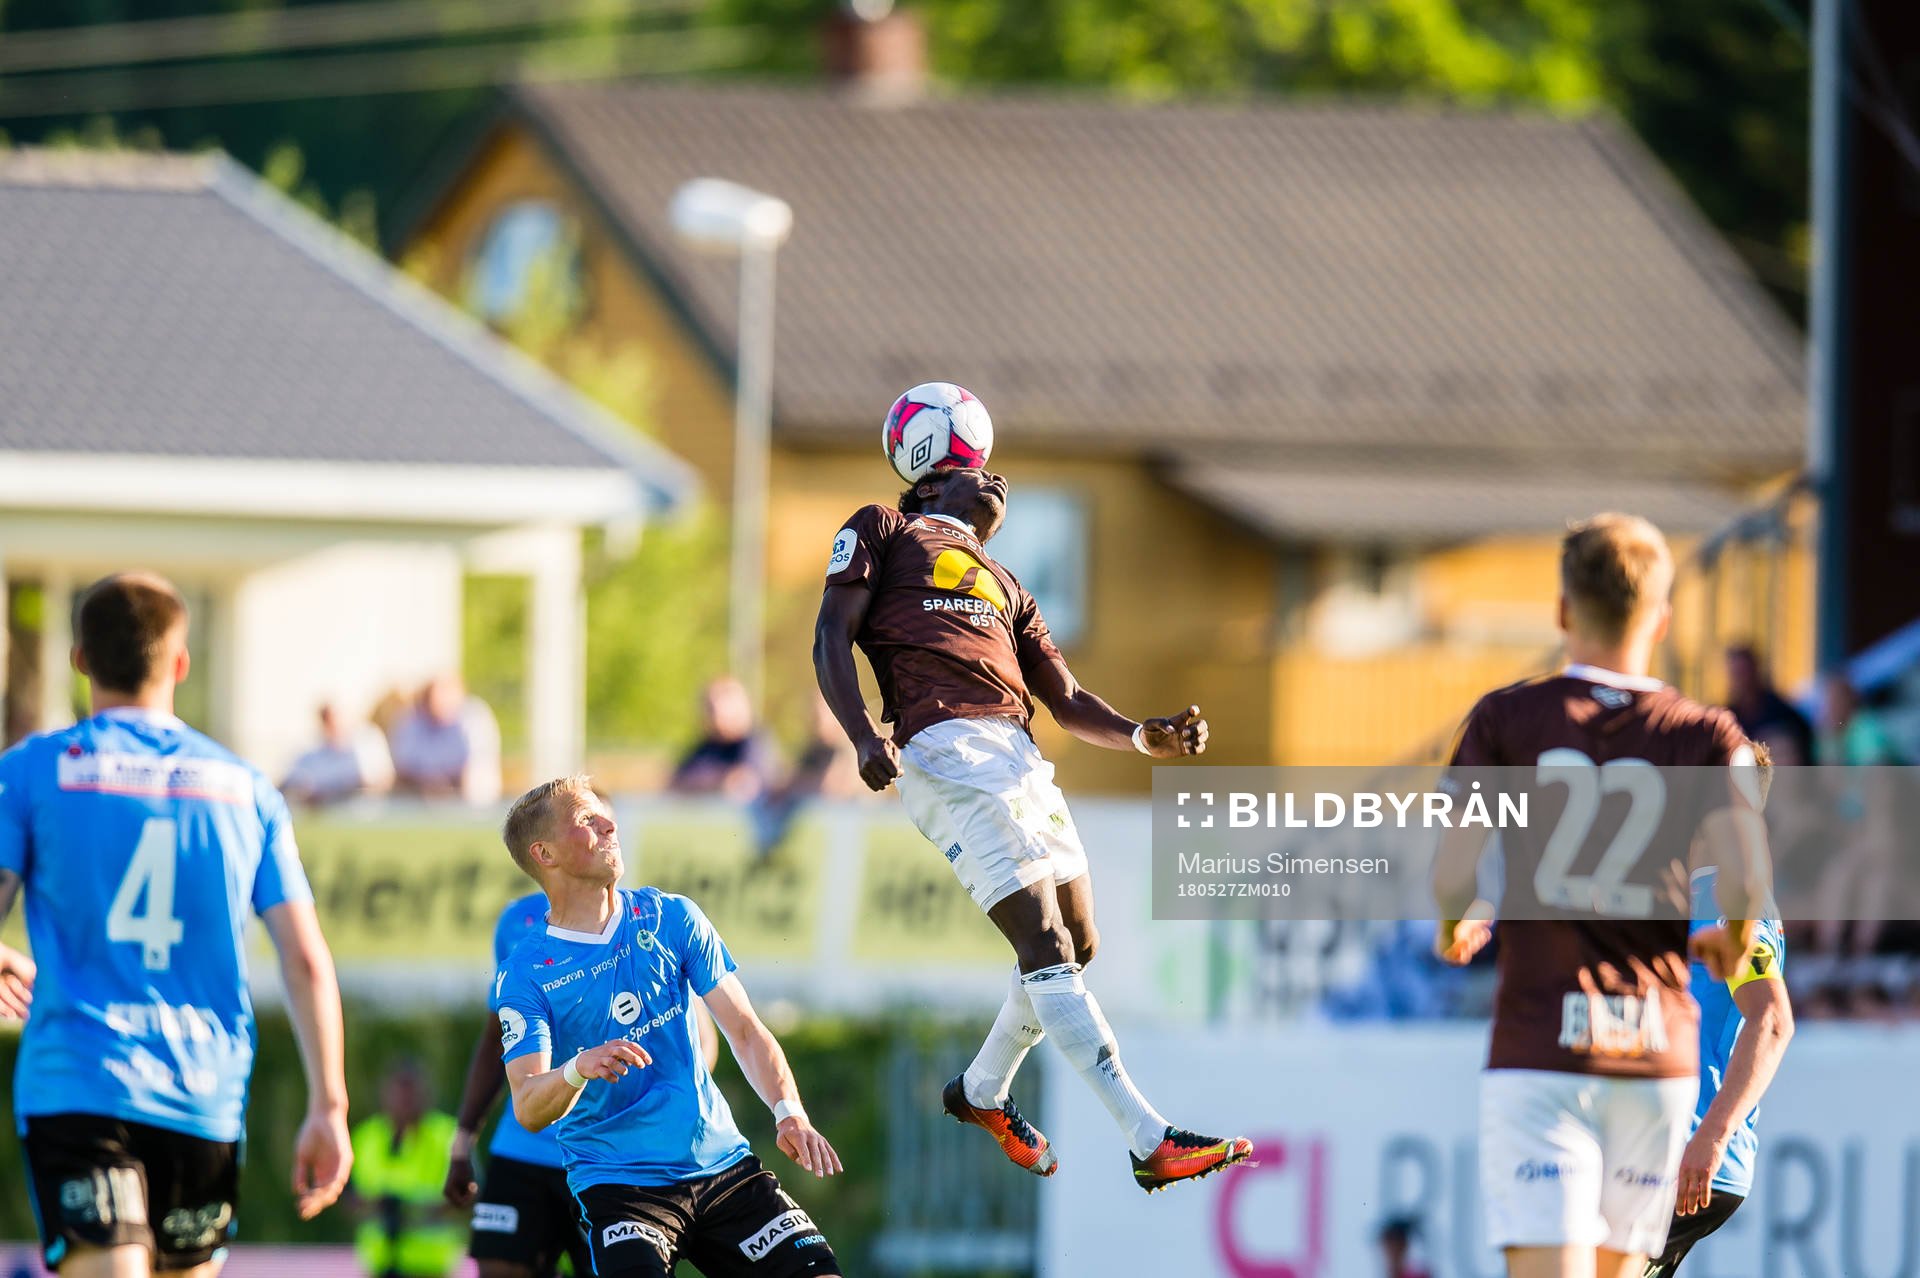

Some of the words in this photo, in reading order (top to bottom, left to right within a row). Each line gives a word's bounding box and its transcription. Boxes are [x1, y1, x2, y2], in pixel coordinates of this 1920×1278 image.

[969, 614, 998, 628] ØST
[1535, 747, 1667, 918] 22
[106, 817, 184, 970] 4
[542, 968, 585, 993] macron
